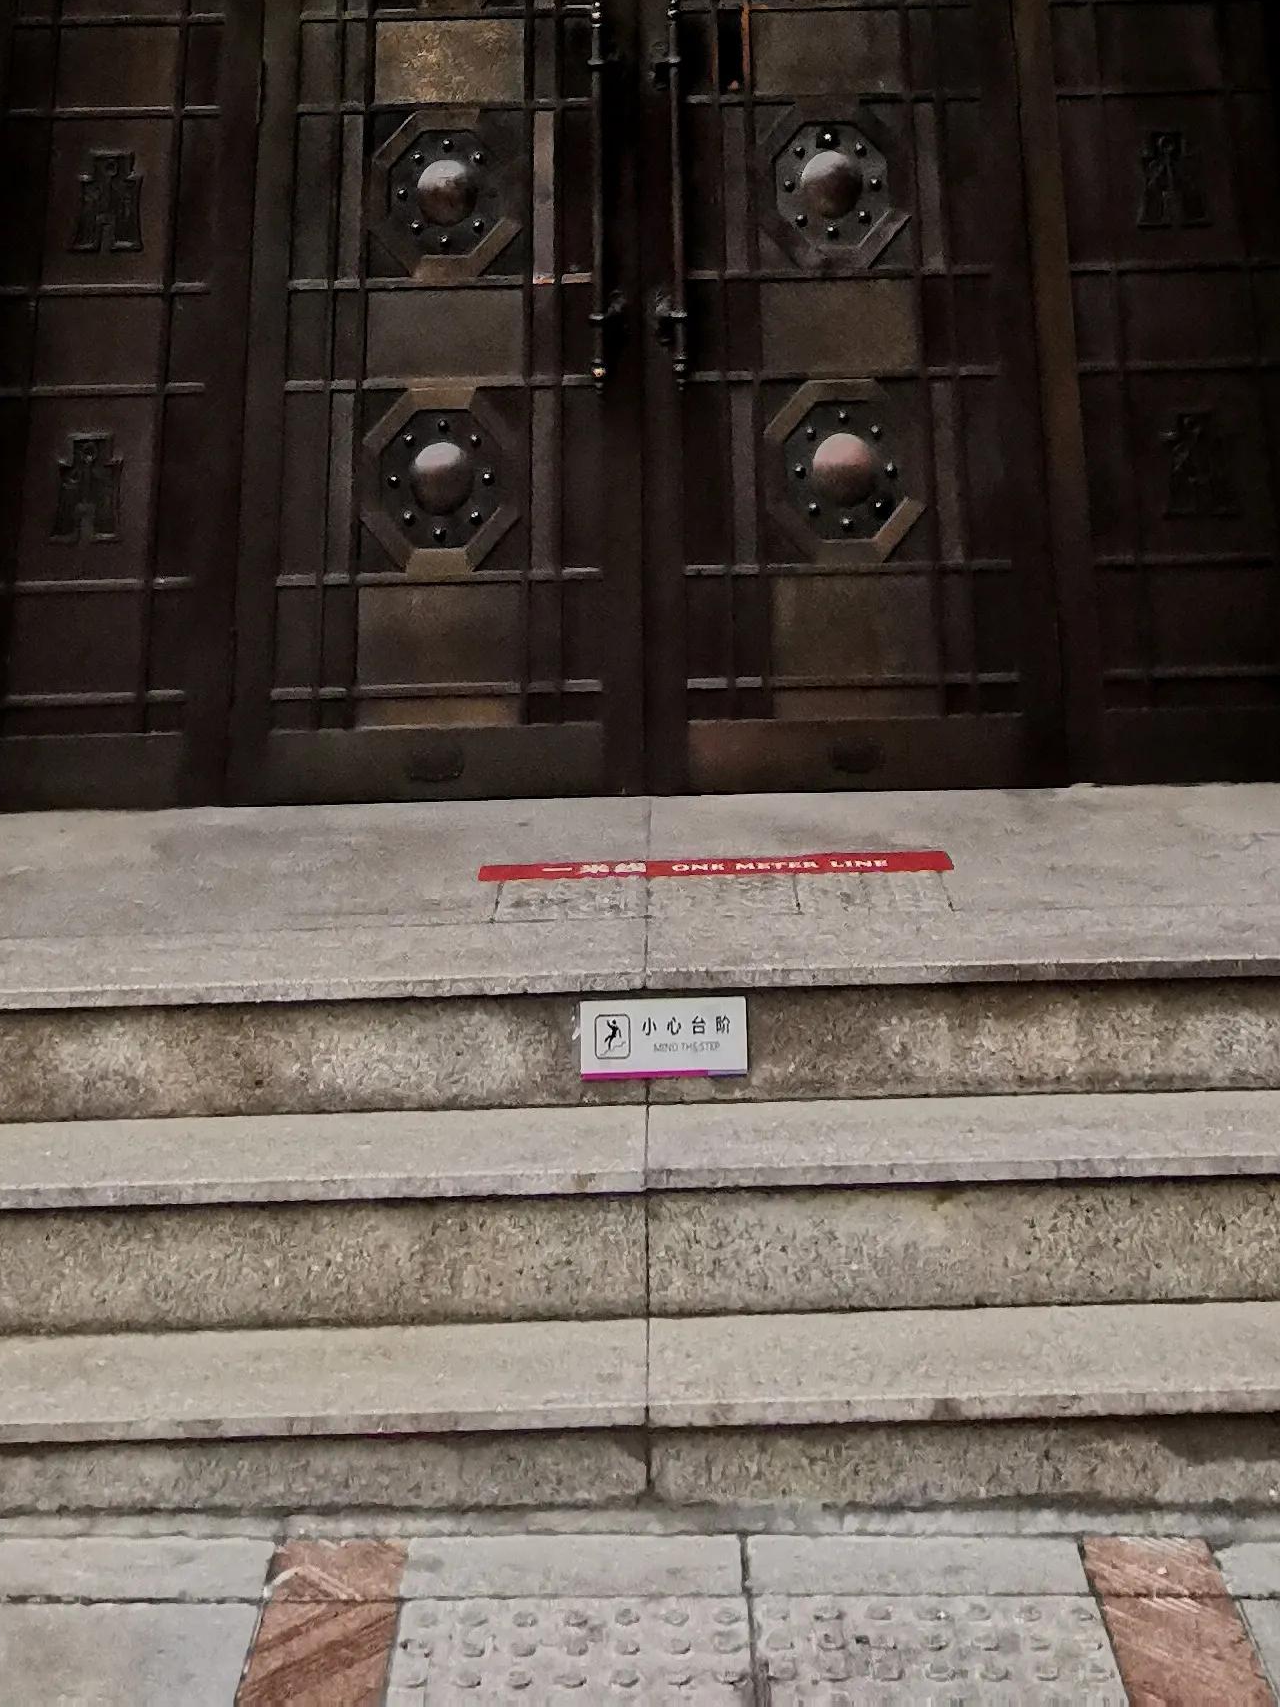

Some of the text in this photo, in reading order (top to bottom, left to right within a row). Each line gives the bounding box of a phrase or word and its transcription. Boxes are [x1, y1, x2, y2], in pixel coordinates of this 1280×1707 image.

[671, 862, 725, 872] ONE
[735, 860, 819, 871] METER
[829, 858, 888, 869] LINE
[641, 1014, 731, 1036] 小心台阶
